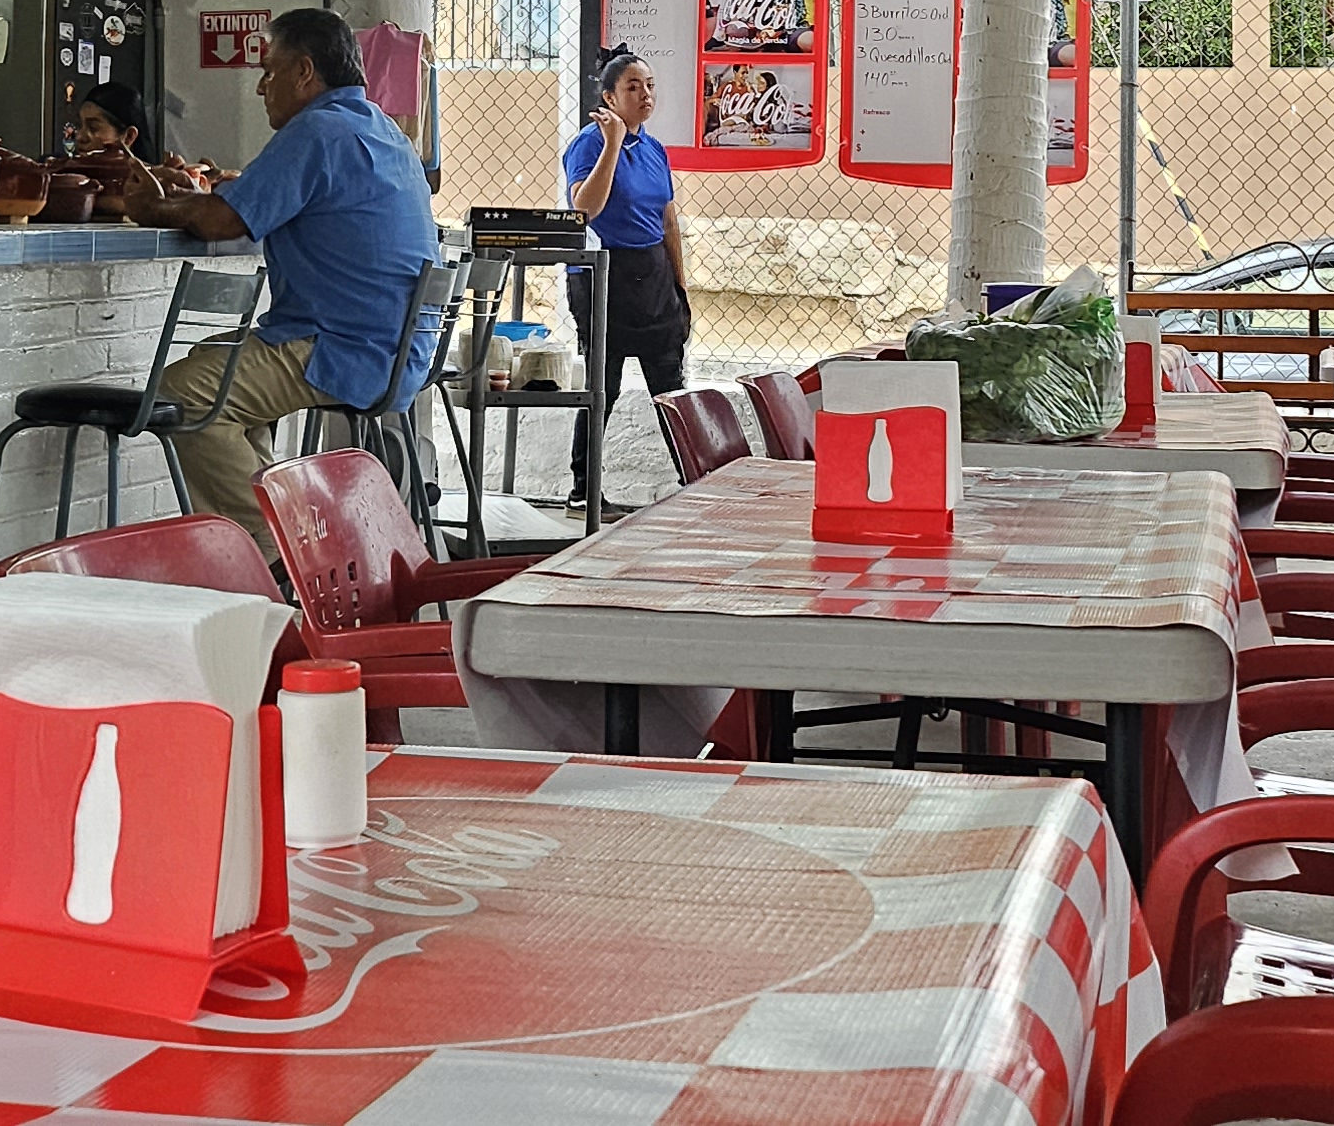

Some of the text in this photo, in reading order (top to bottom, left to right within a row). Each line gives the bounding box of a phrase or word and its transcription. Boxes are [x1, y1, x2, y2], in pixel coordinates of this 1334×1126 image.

[857, 3, 869, 19] 3
[871, 0, 928, 20] Burritos
[203, 14, 268, 32] EXTINTOR
[727, 36, 788, 45] Magia de Verdad
[856, 46, 867, 59] 3
[869, 46, 936, 65] Quesadillas
[863, 108, 891, 116] Refresco
[856, 143, 862, 152] $
[546, 212, 561, 221] Star
[575, 213, 584, 225] 3
